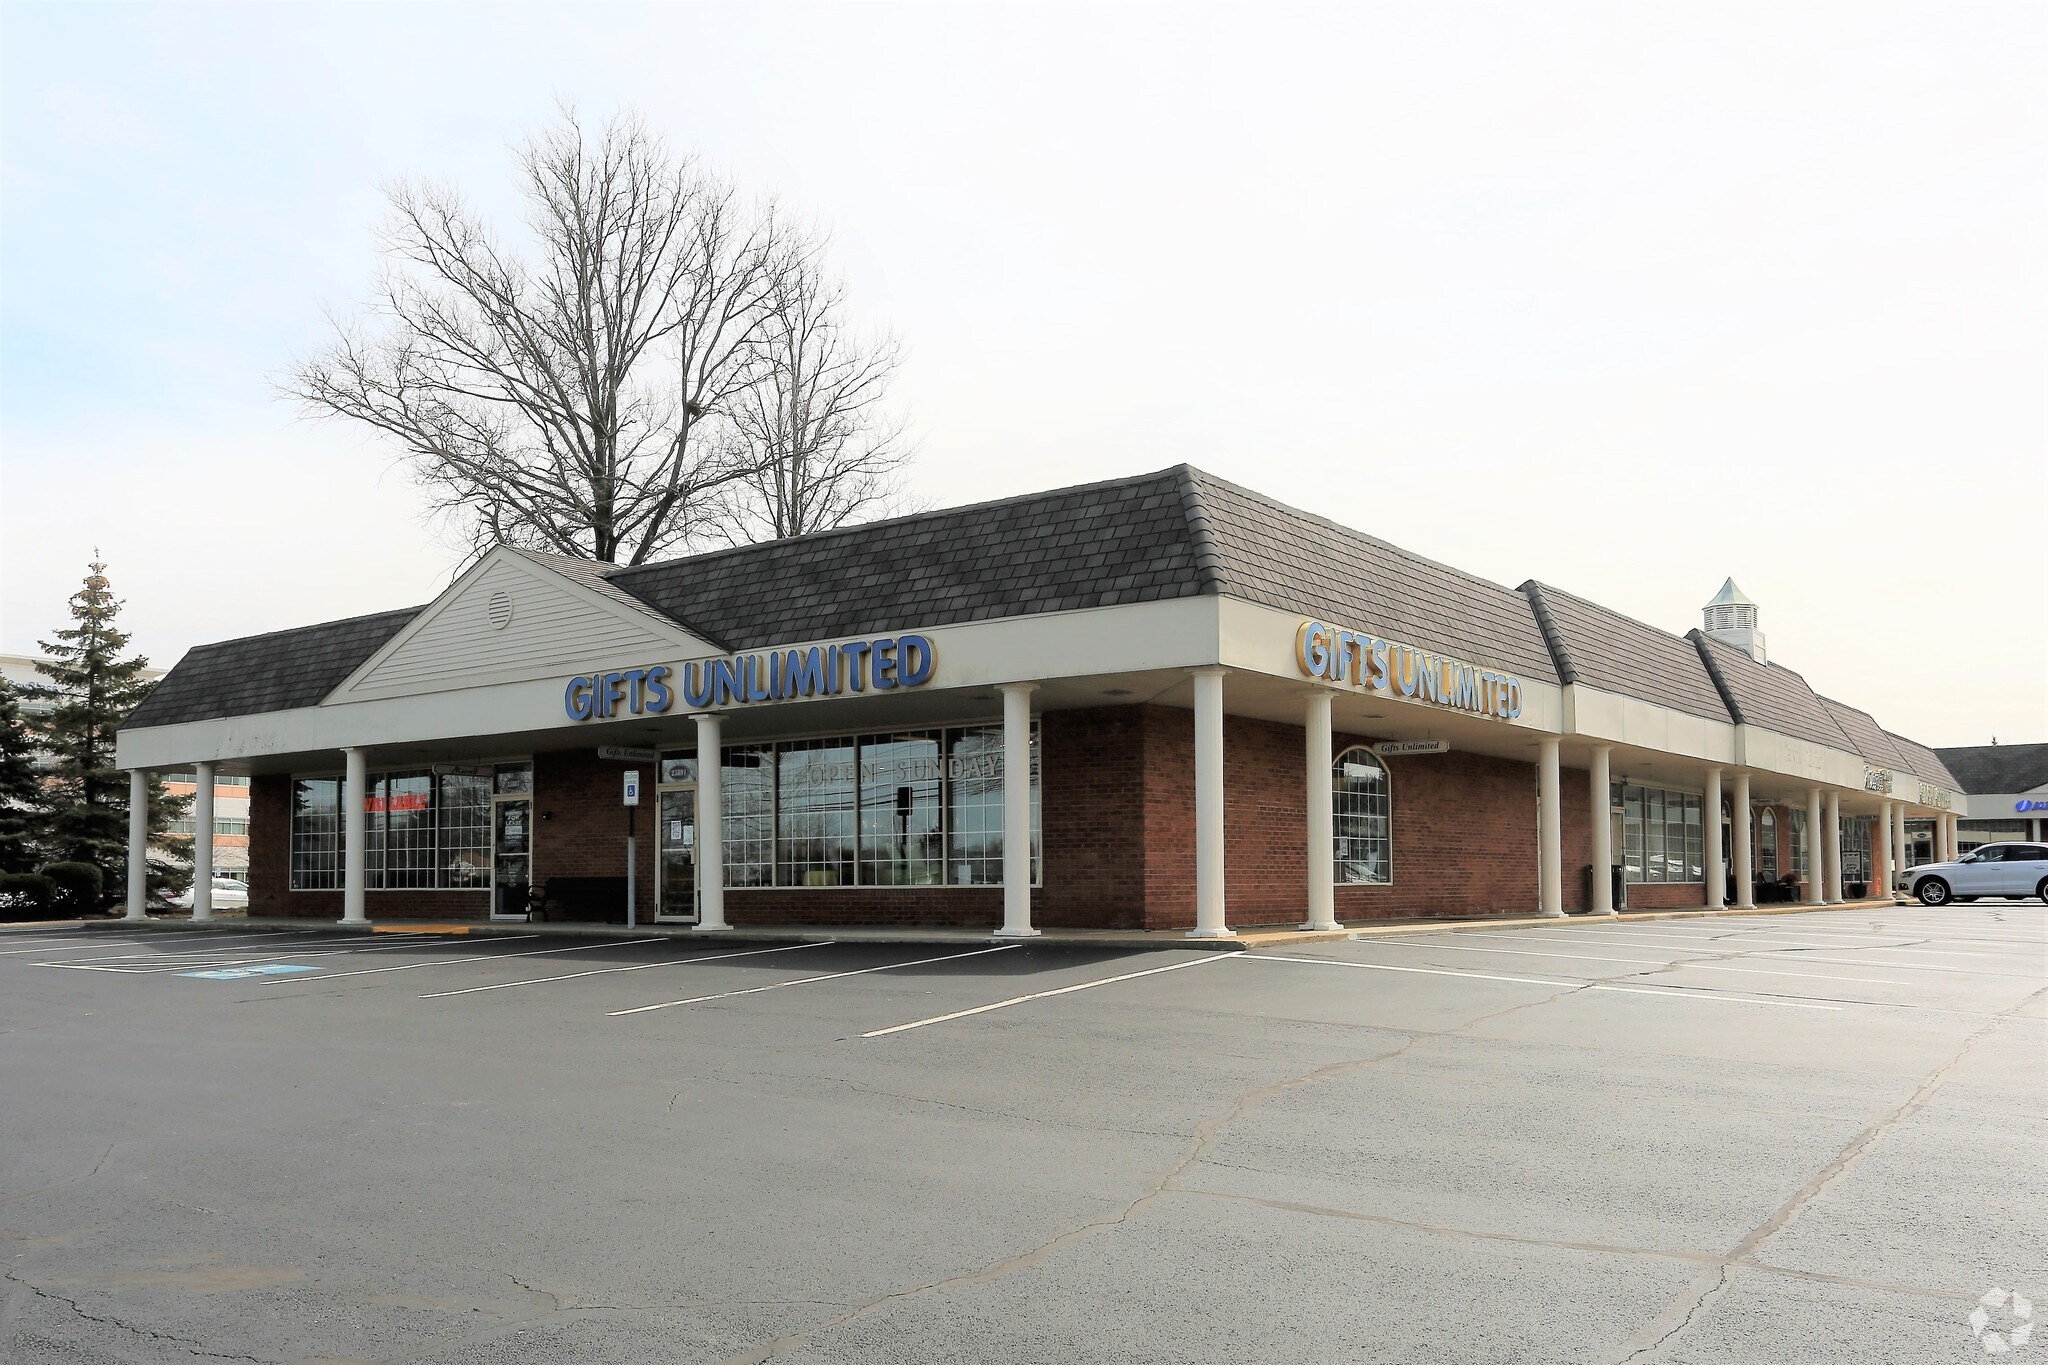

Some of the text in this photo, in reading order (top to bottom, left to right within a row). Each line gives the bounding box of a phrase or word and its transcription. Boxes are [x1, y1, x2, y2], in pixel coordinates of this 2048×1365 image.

[564, 634, 937, 721] GIFTS UNLIMITED
[1296, 621, 1523, 719] GIFTS UNLIMITED
[1381, 741, 1439, 753] Gifts Unlimited
[808, 763, 875, 787] OPEN
[365, 794, 427, 811] VAILABLE
